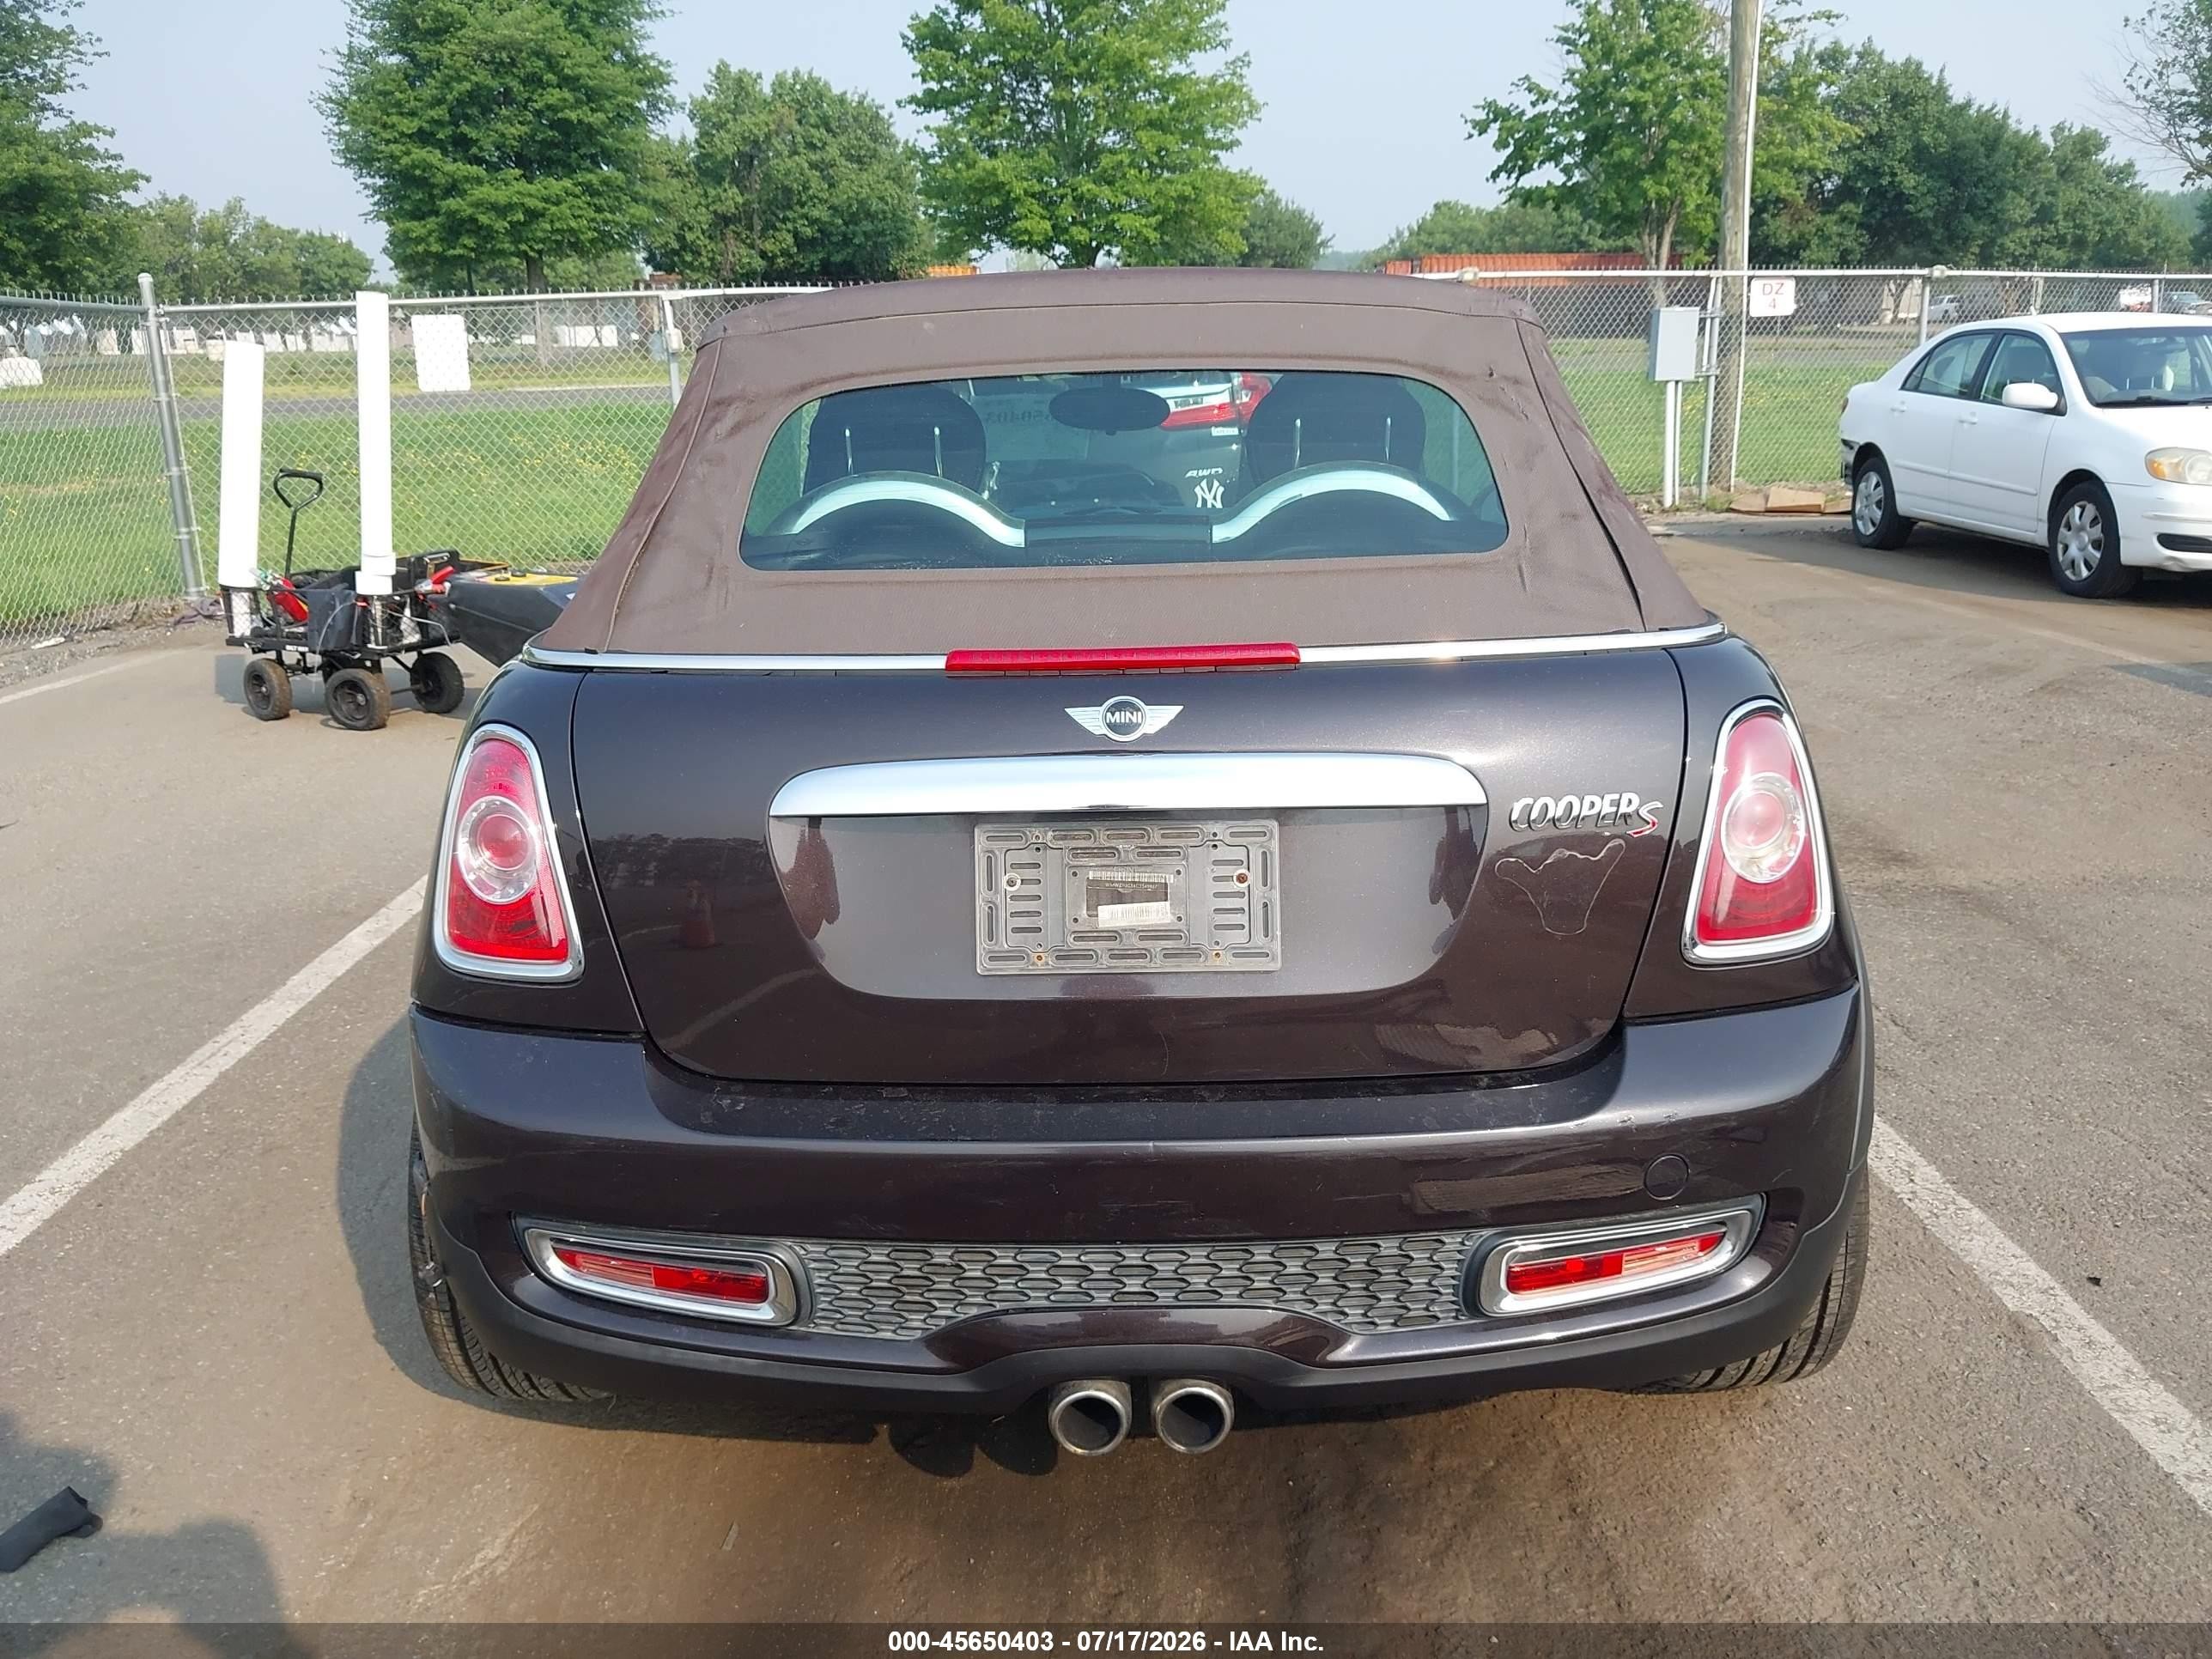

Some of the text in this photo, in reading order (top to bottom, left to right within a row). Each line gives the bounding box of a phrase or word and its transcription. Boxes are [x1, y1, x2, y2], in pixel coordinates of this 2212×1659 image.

[1763, 283, 1784, 296] DZ
[1769, 297, 1776, 309] 4
[1185, 467, 1224, 478] AWD
[1194, 478, 1225, 509] NY
[1105, 710, 1142, 725] MINI
[1510, 792, 1664, 838] COOPER S
